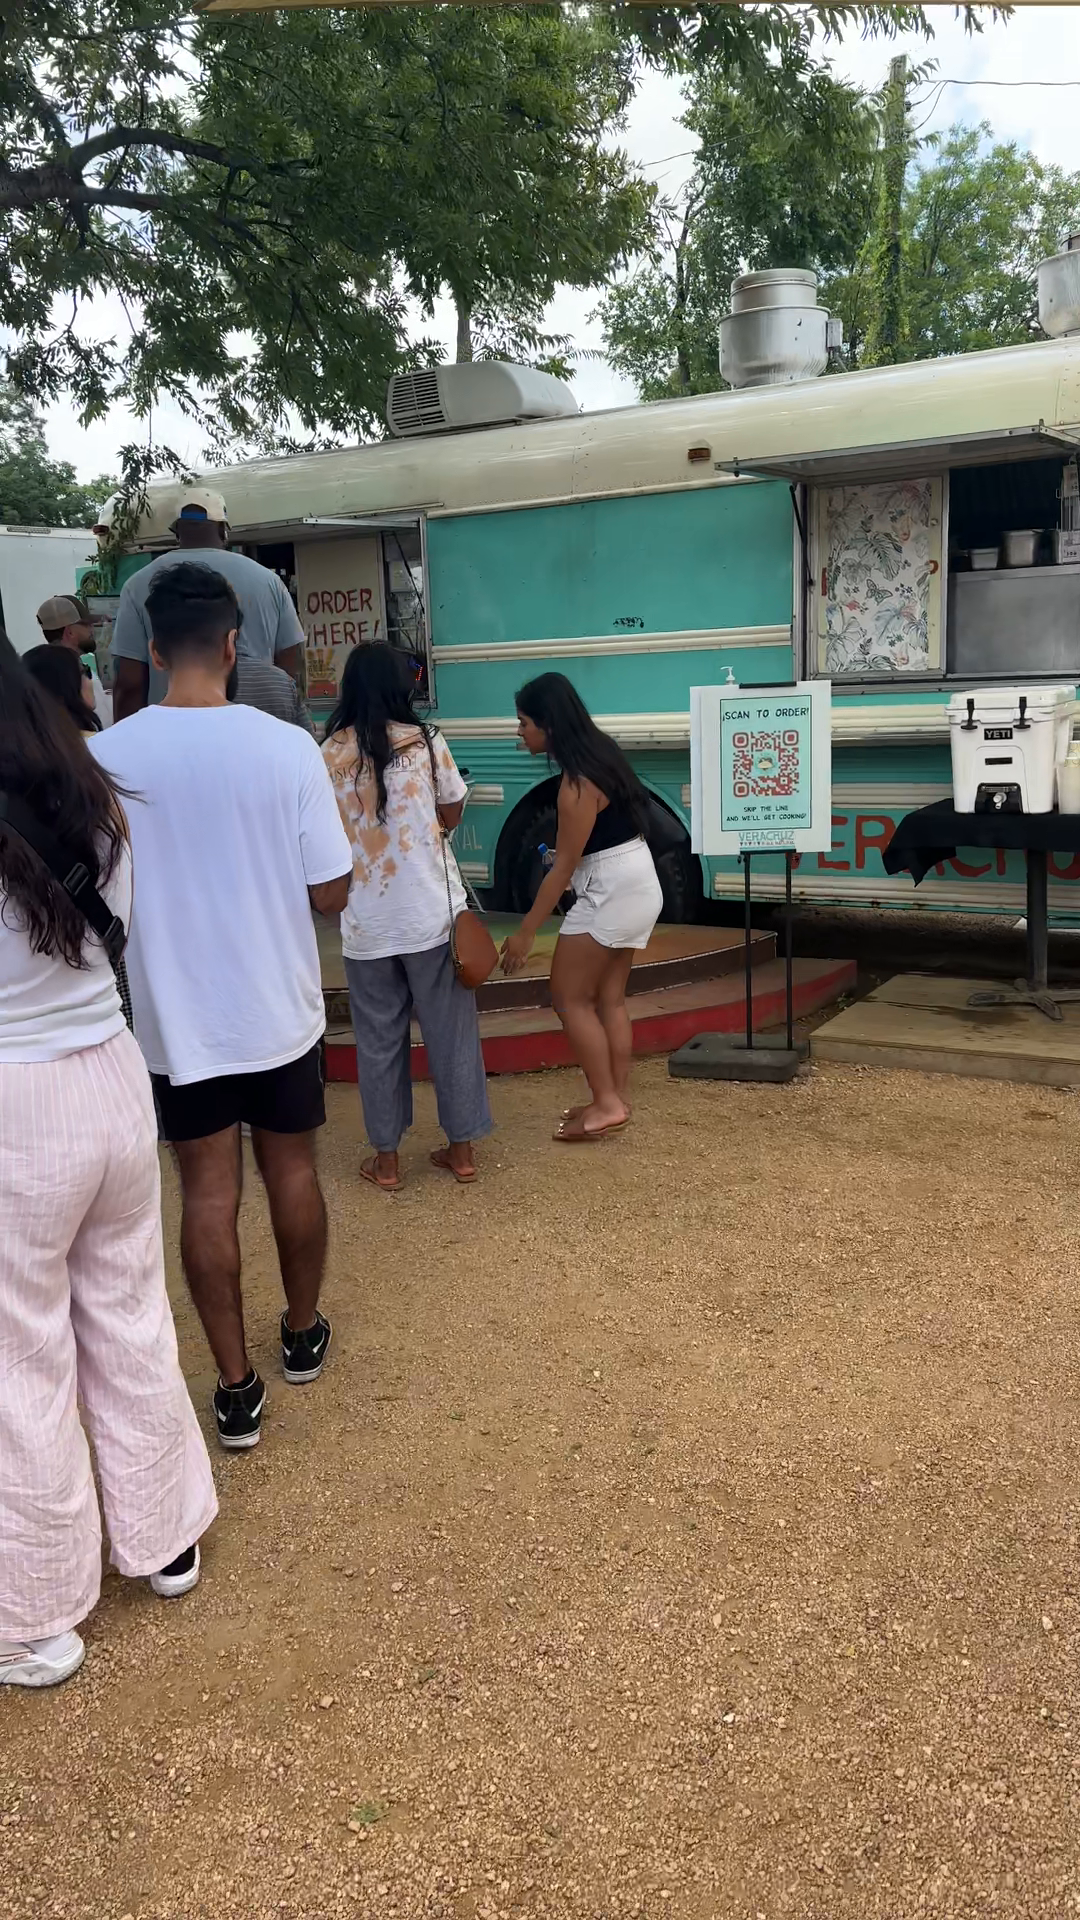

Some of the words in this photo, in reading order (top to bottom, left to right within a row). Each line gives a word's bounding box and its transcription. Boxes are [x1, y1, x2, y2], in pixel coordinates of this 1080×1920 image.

[307, 588, 373, 615] ORDER
[722, 710, 750, 722] ¡SCAN
[757, 709, 770, 719] TO
[775, 707, 810, 718] ORDER!
[985, 730, 1012, 739] YETI
[779, 812, 807, 820] COOKING!
